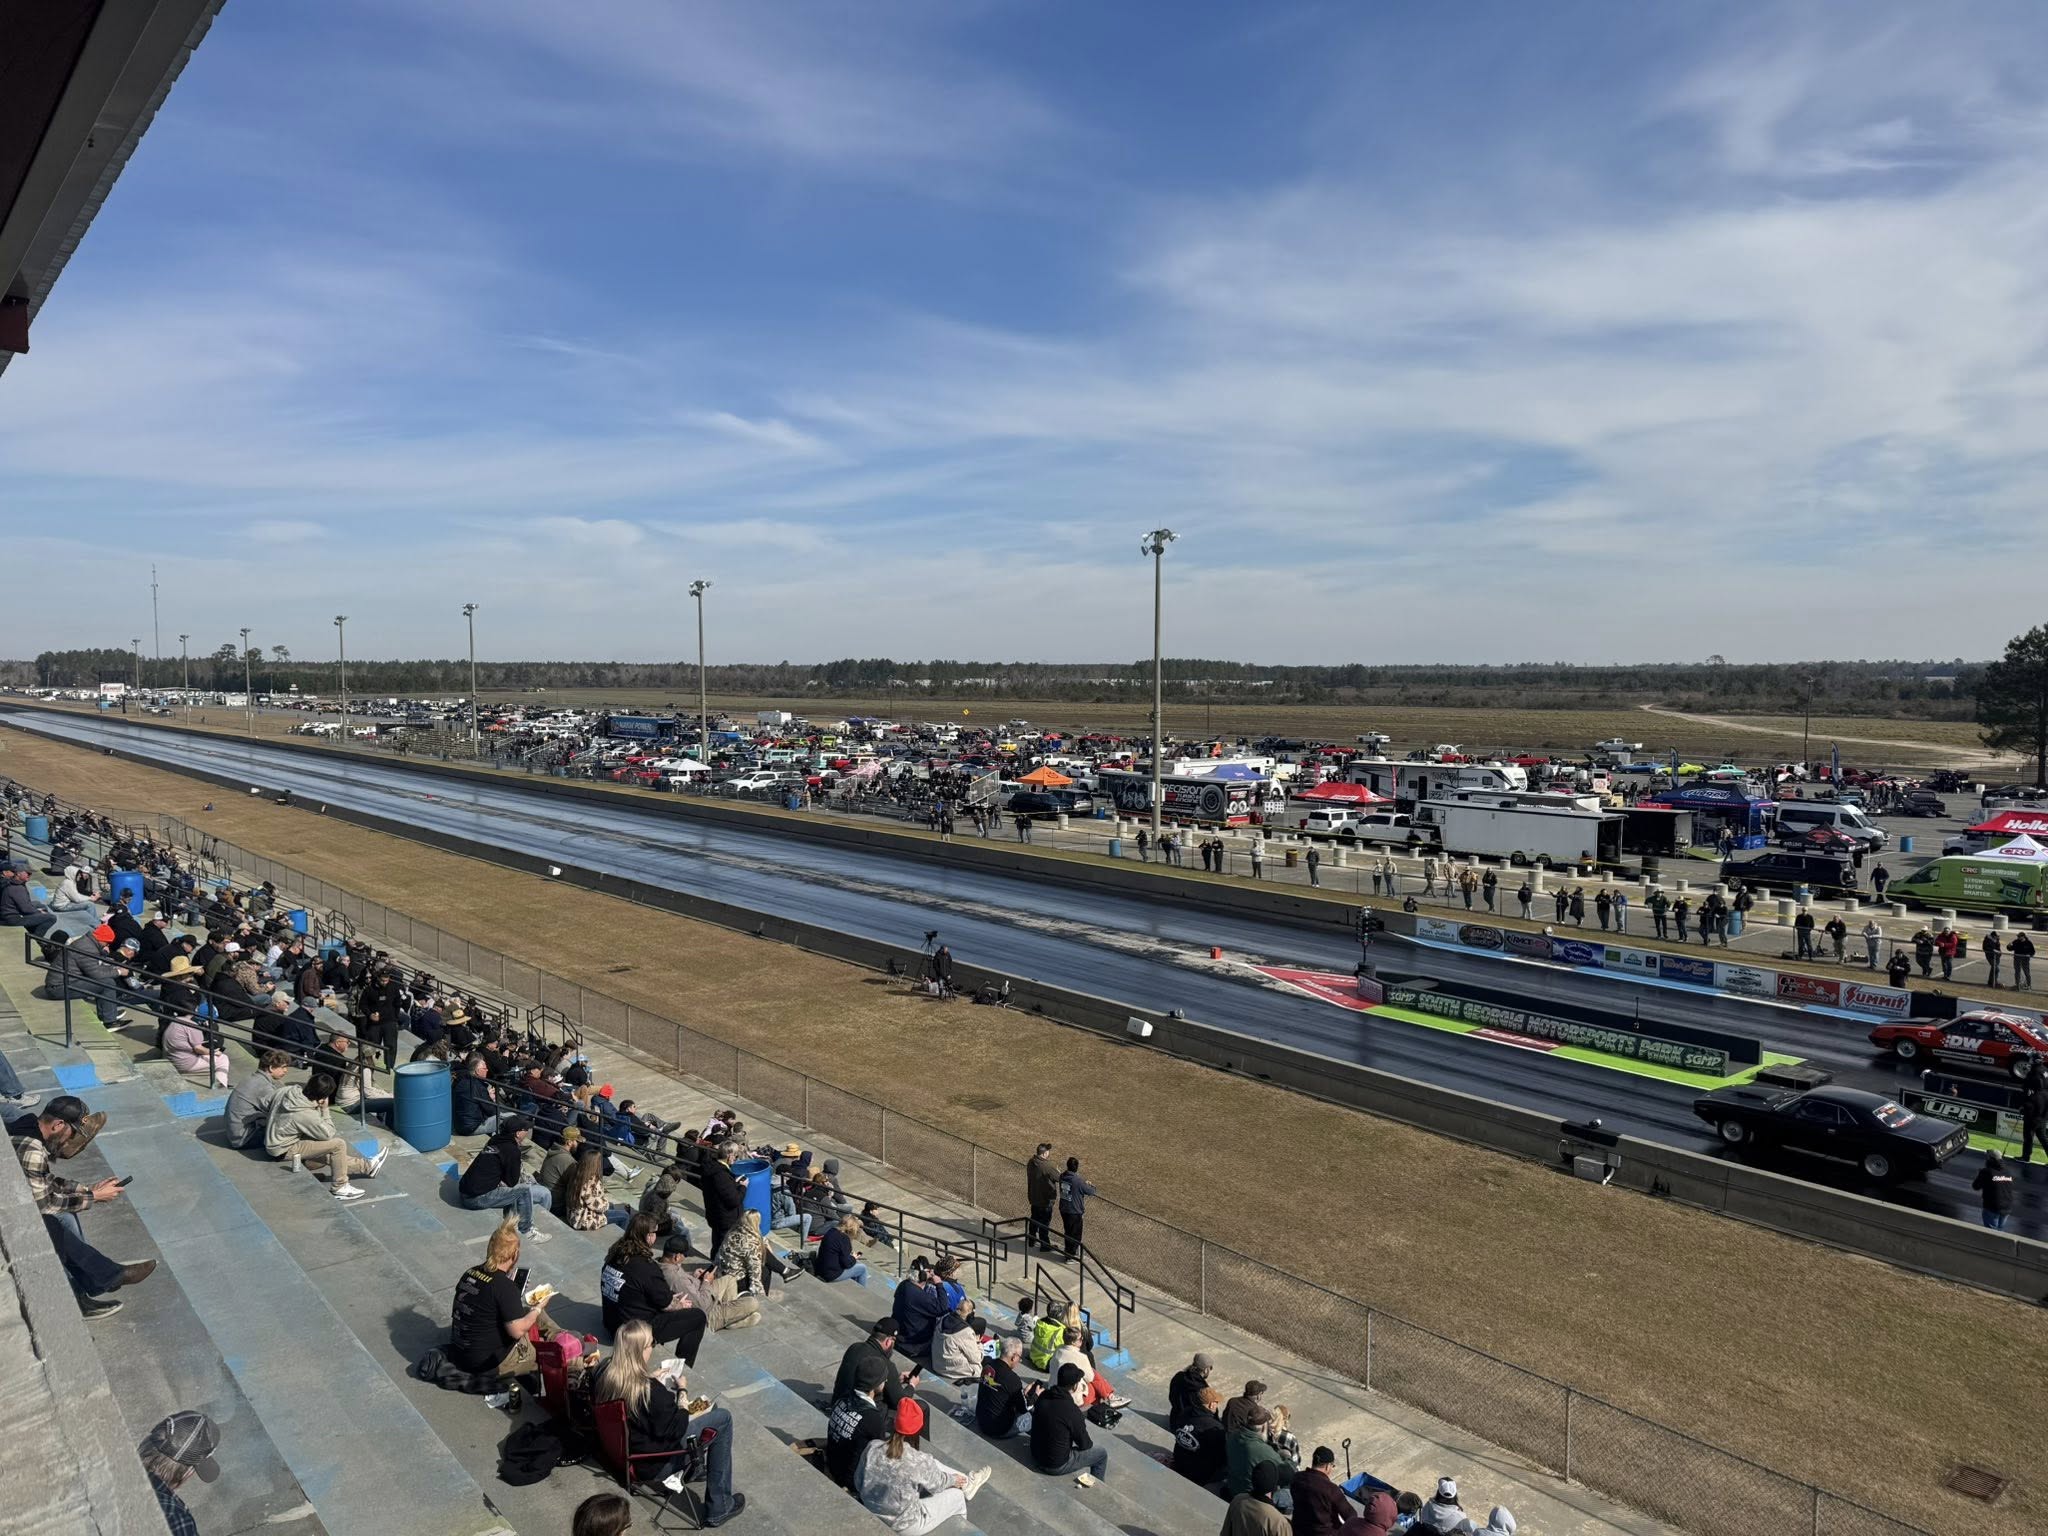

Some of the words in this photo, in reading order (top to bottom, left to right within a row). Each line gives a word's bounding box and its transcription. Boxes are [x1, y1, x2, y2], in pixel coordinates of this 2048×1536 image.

[1390, 991, 1416, 1003] SGMP
[1418, 993, 1461, 1017] SOUTH
[1463, 1003, 1525, 1030] GEORGIA
[1527, 1015, 1637, 1054] MOTORSPORTS
[1639, 1039, 1685, 1064] PARK
[1685, 1053, 1723, 1067] SGMP
[1950, 1035, 1984, 1050] DW
[1926, 1100, 1977, 1121] UPR
